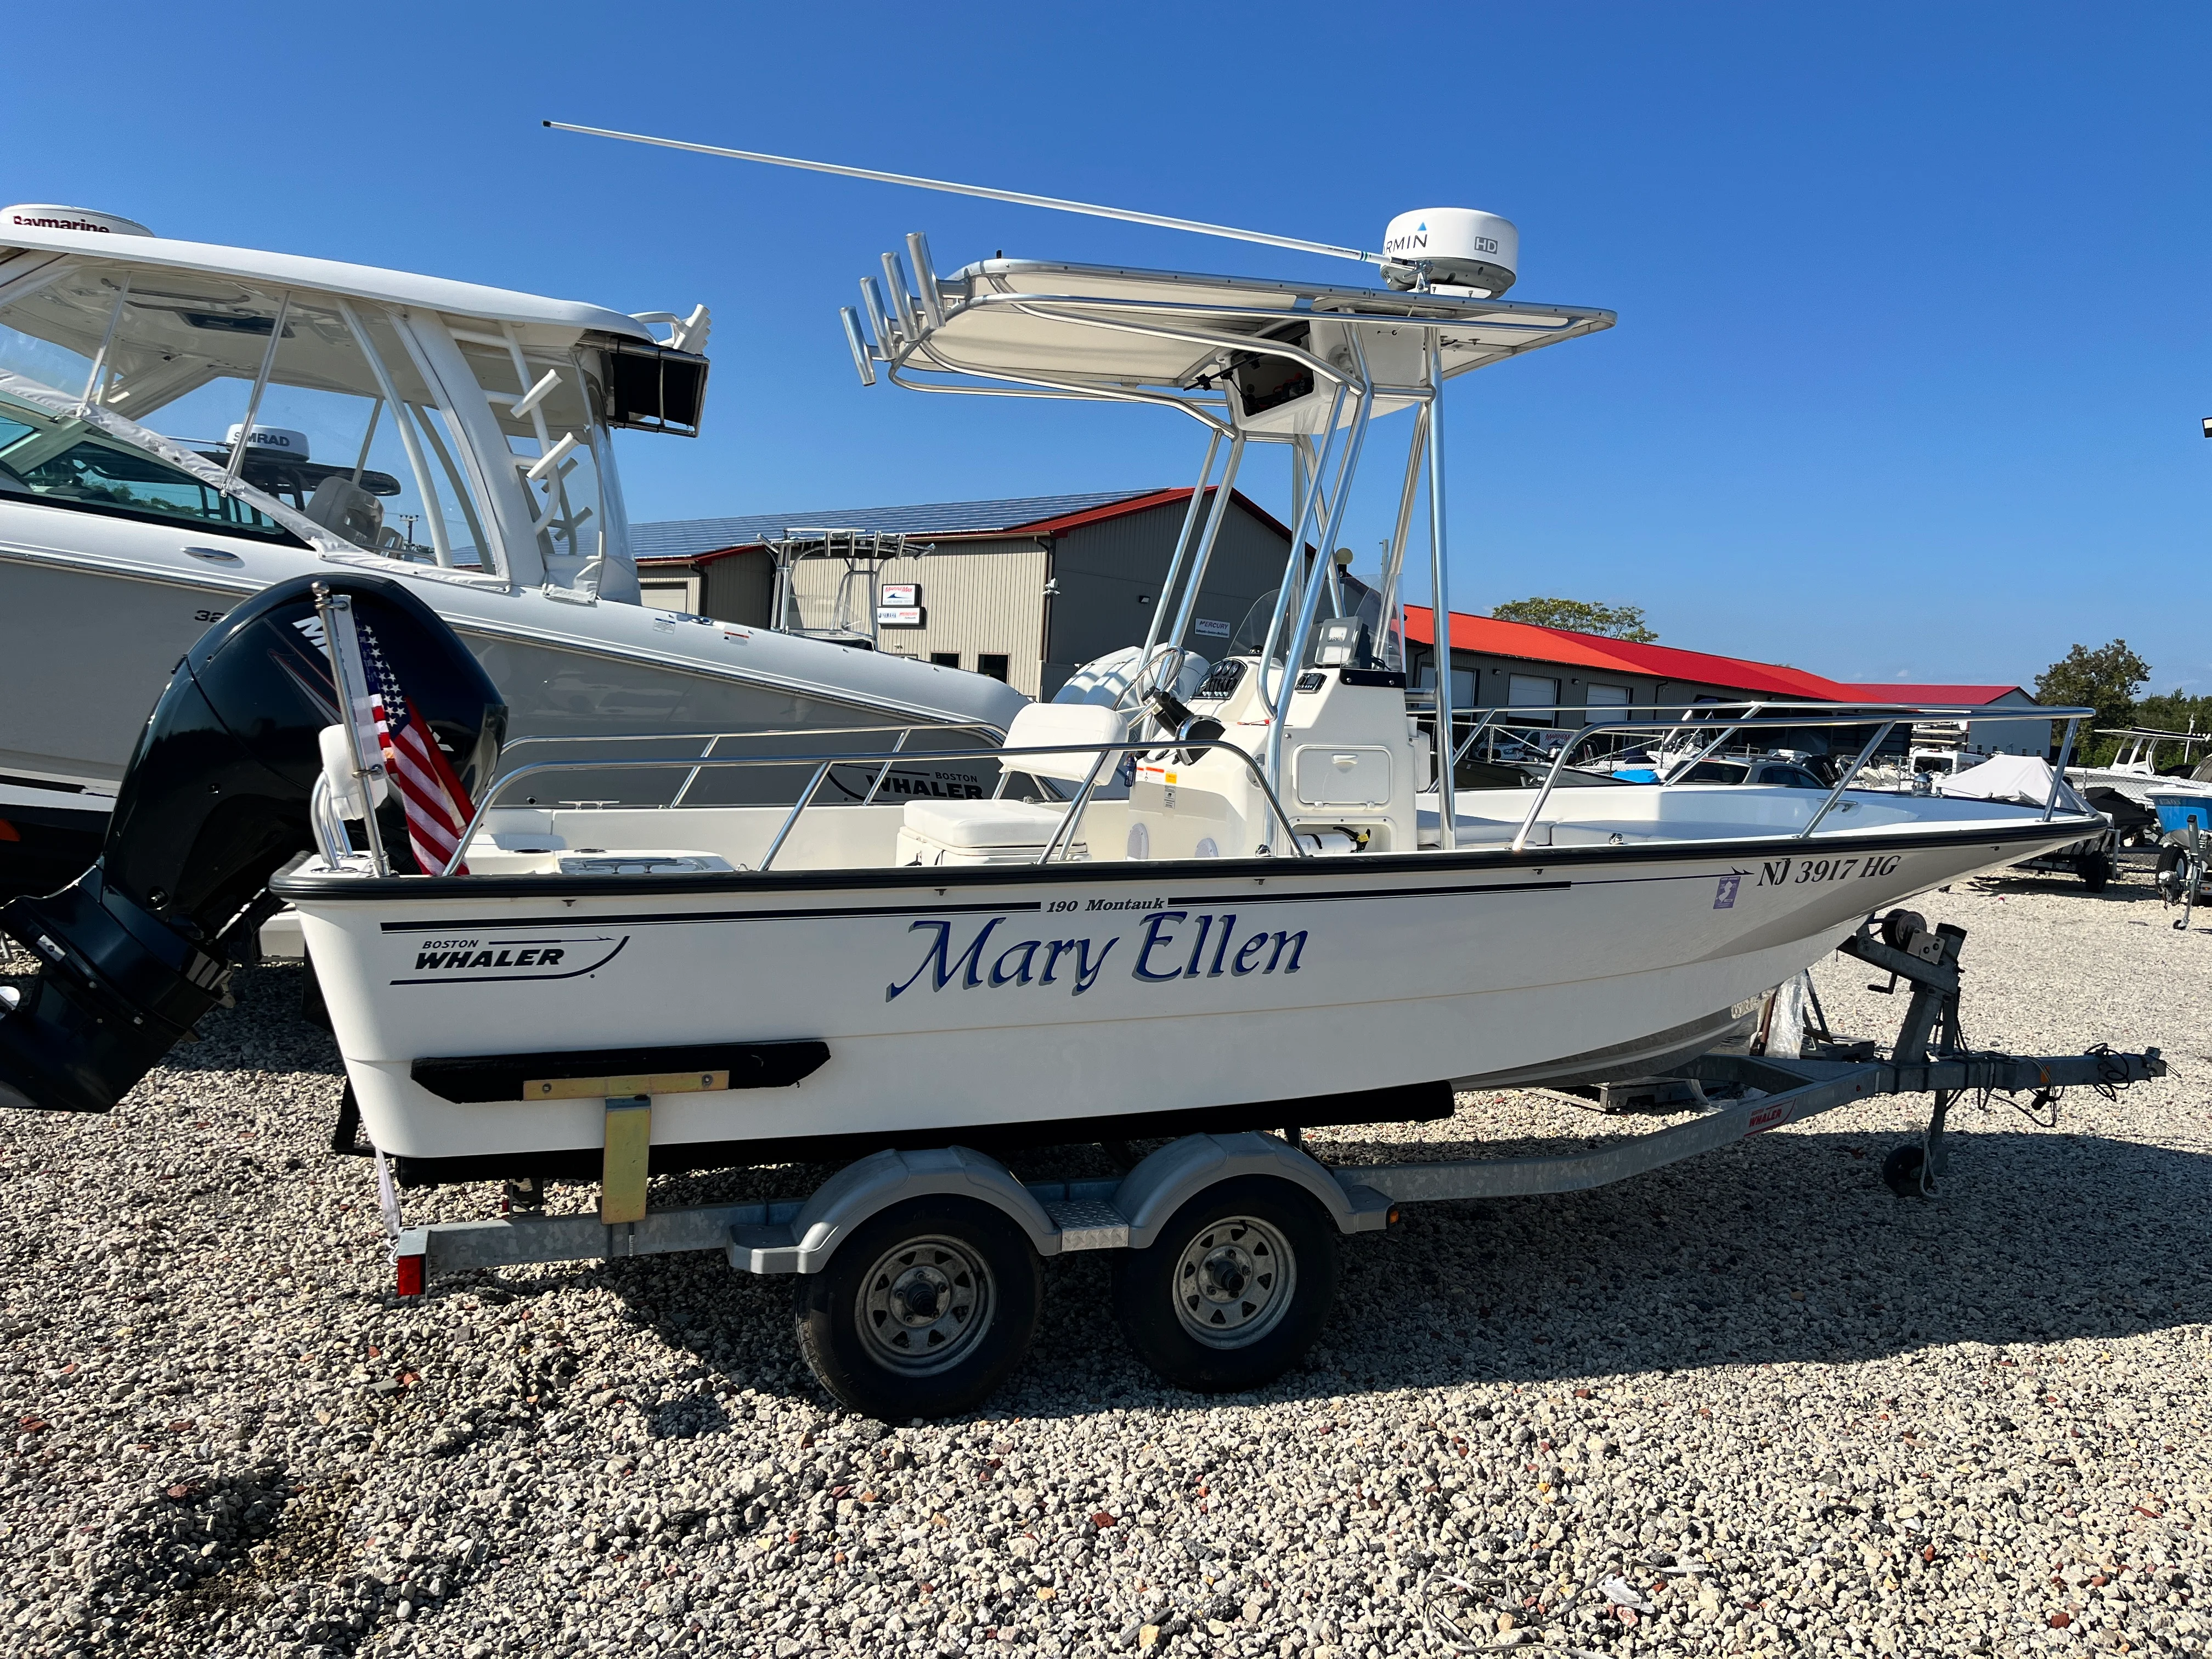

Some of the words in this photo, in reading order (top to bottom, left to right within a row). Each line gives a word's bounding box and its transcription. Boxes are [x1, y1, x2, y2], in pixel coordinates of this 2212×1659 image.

[13, 216, 110, 233] Raymarine
[1477, 238, 1497, 253] HD
[233, 432, 290, 447] SMRAD
[1199, 620, 1229, 630] MERCURY
[935, 772, 978, 783] BOSTON
[865, 774, 985, 799] WHALER
[1757, 859, 1791, 886] NJ
[1795, 859, 1859, 883] 3917
[1858, 855, 1901, 878] HG
[1046, 900, 1079, 913] 190
[1085, 896, 1165, 912] Montauk
[422, 939, 479, 950] BOSTON
[415, 949, 565, 970] WHALER
[885, 917, 1120, 1003] Mary
[1131, 911, 1309, 983] Ellen
[1749, 1108, 1782, 1128] WHALER
